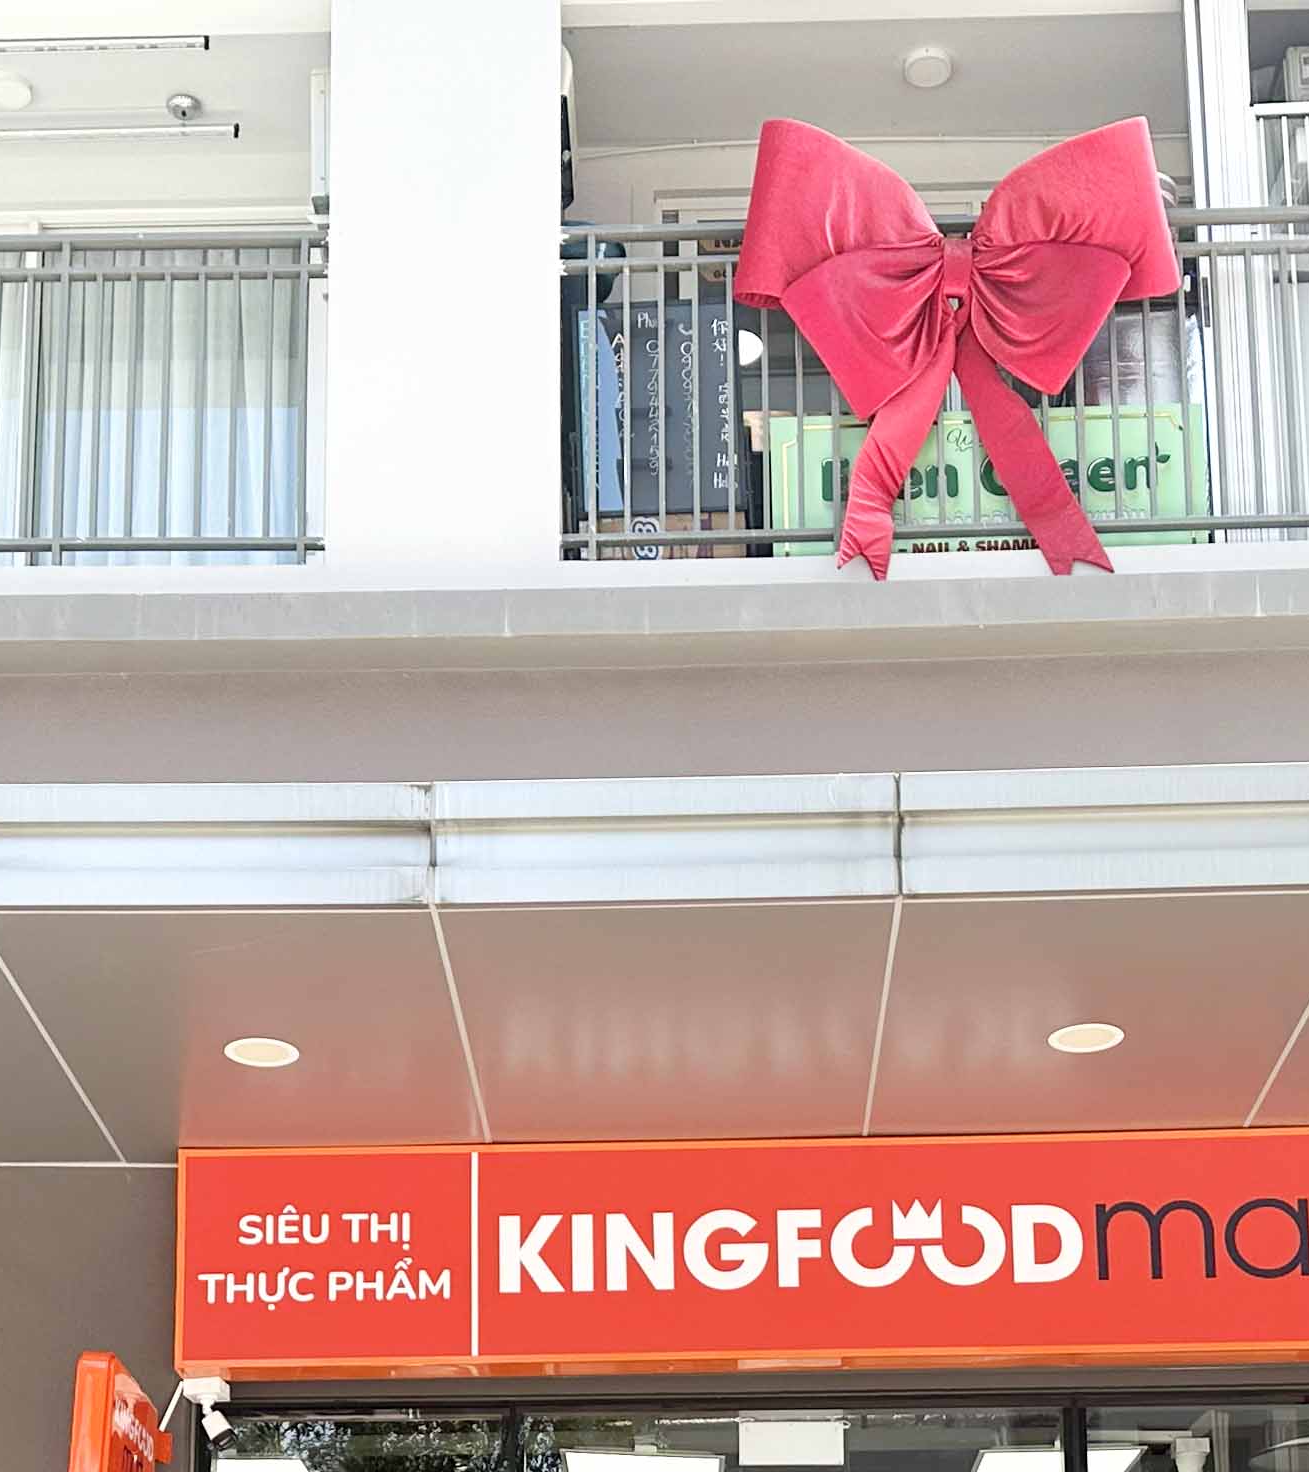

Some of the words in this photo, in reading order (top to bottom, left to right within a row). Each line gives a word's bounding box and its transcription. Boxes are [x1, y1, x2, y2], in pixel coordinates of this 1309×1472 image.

[237, 1204, 330, 1246] SIÊU
[342, 1211, 412, 1251] THỊ
[198, 1267, 315, 1311] THỰC
[328, 1257, 452, 1302] PHẨM
